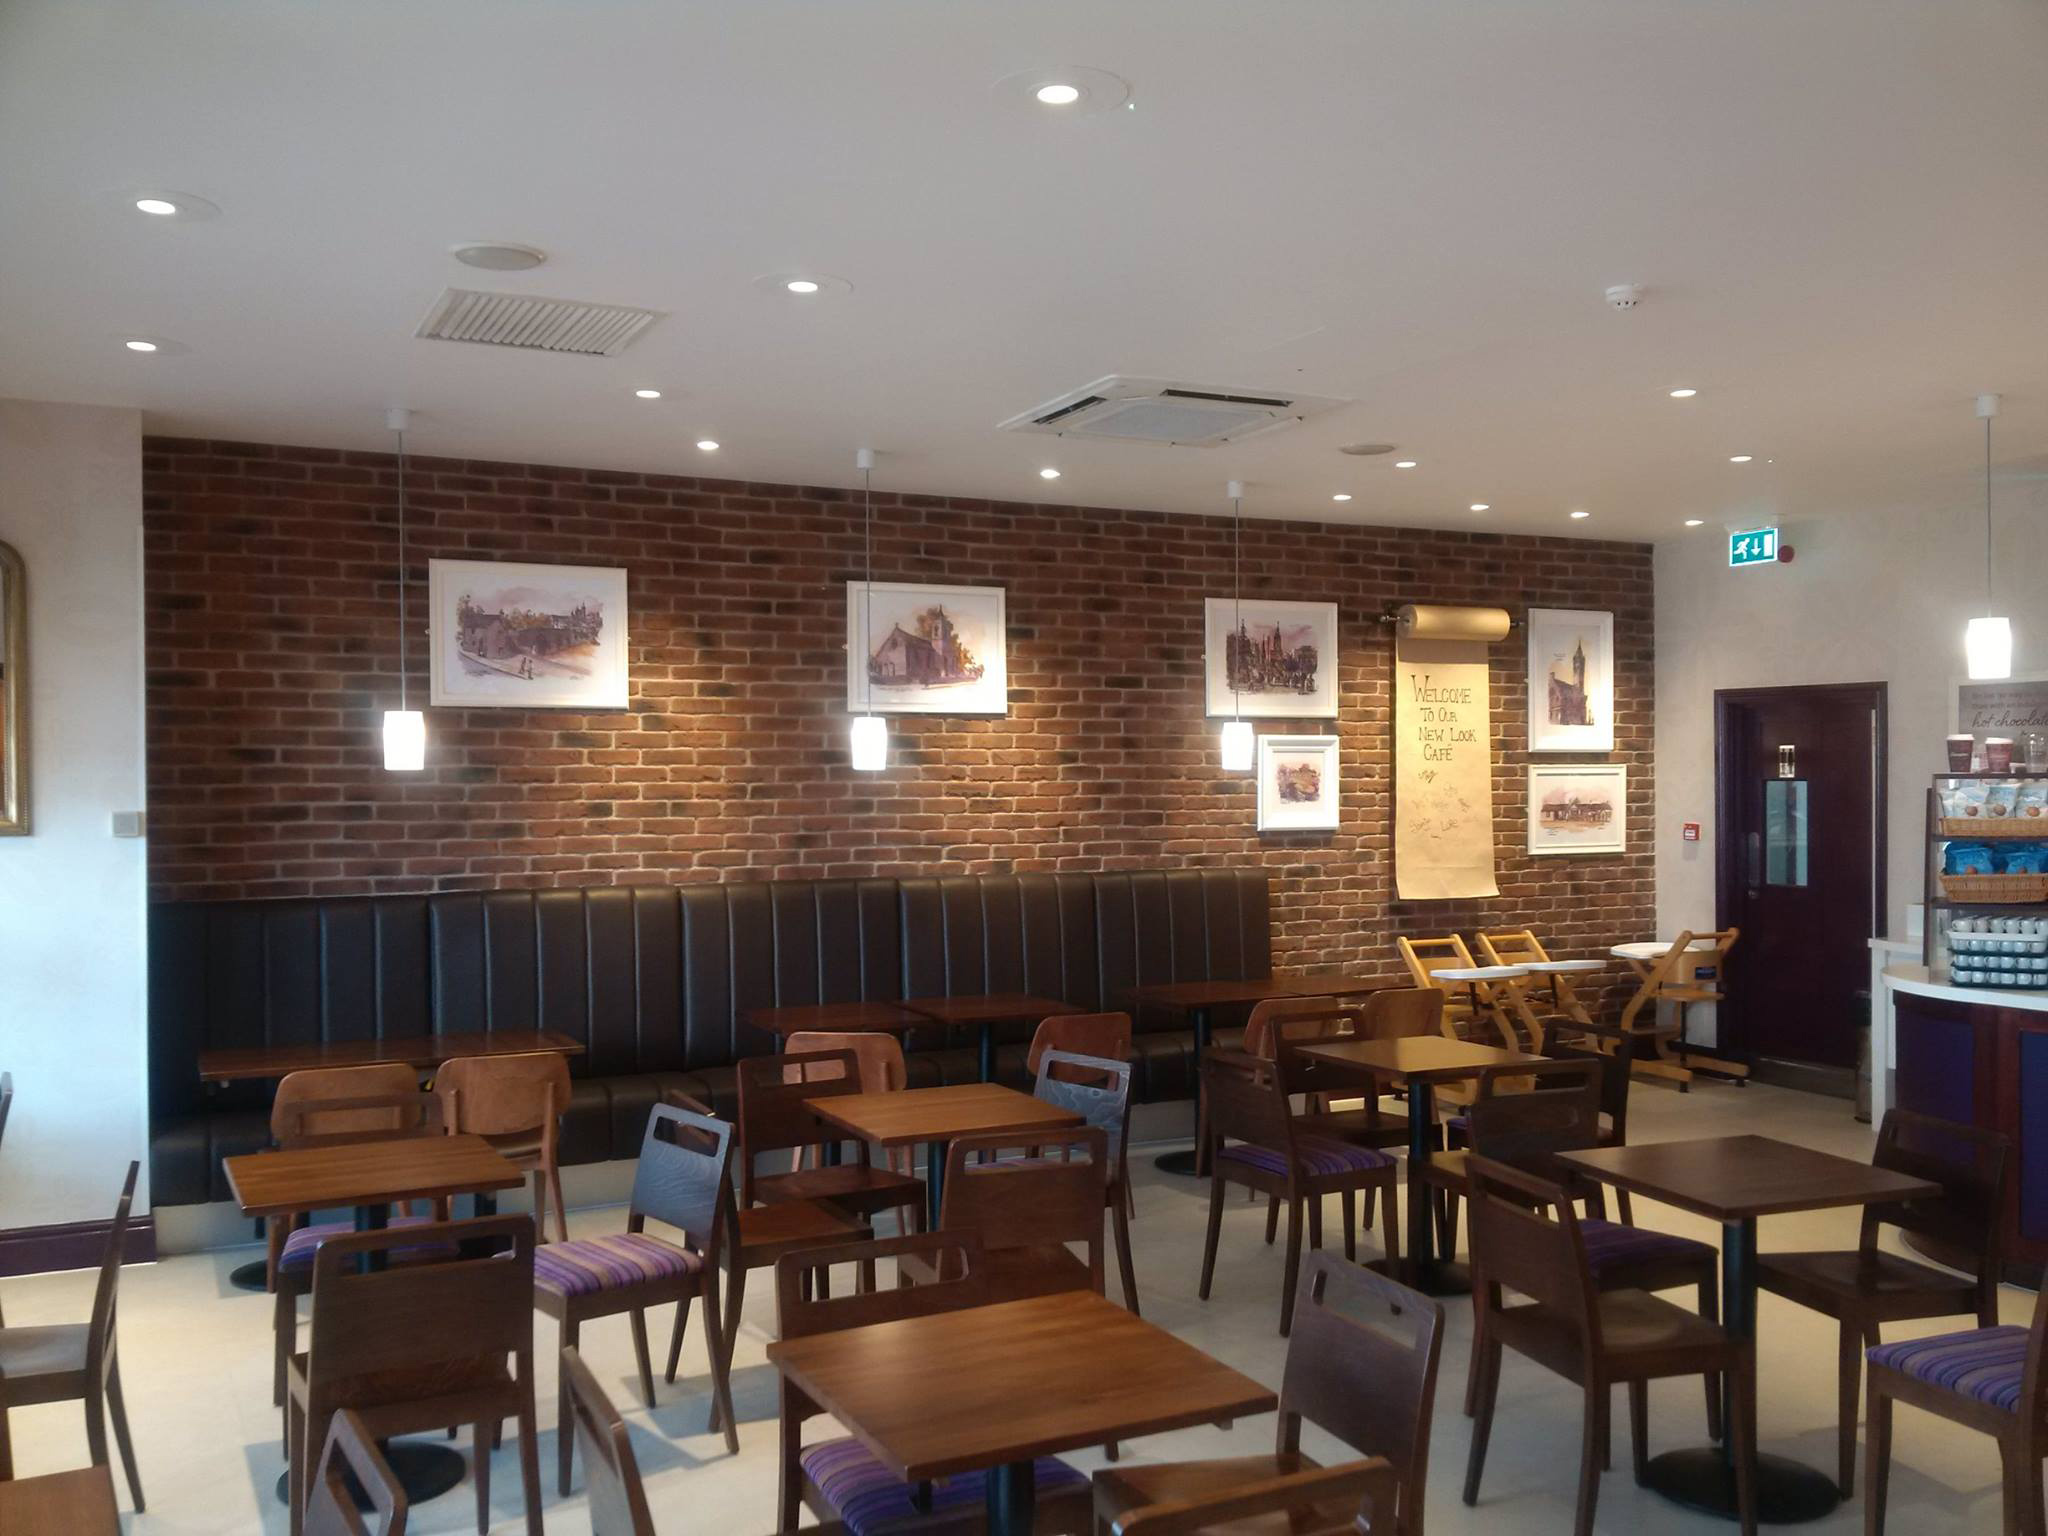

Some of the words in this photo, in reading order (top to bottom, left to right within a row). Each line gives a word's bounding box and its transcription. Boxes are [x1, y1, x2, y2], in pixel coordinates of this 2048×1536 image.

[1411, 674, 1472, 704] WELCOME
[1419, 726, 1444, 742] NEW
[1450, 727, 1477, 742] LOOK
